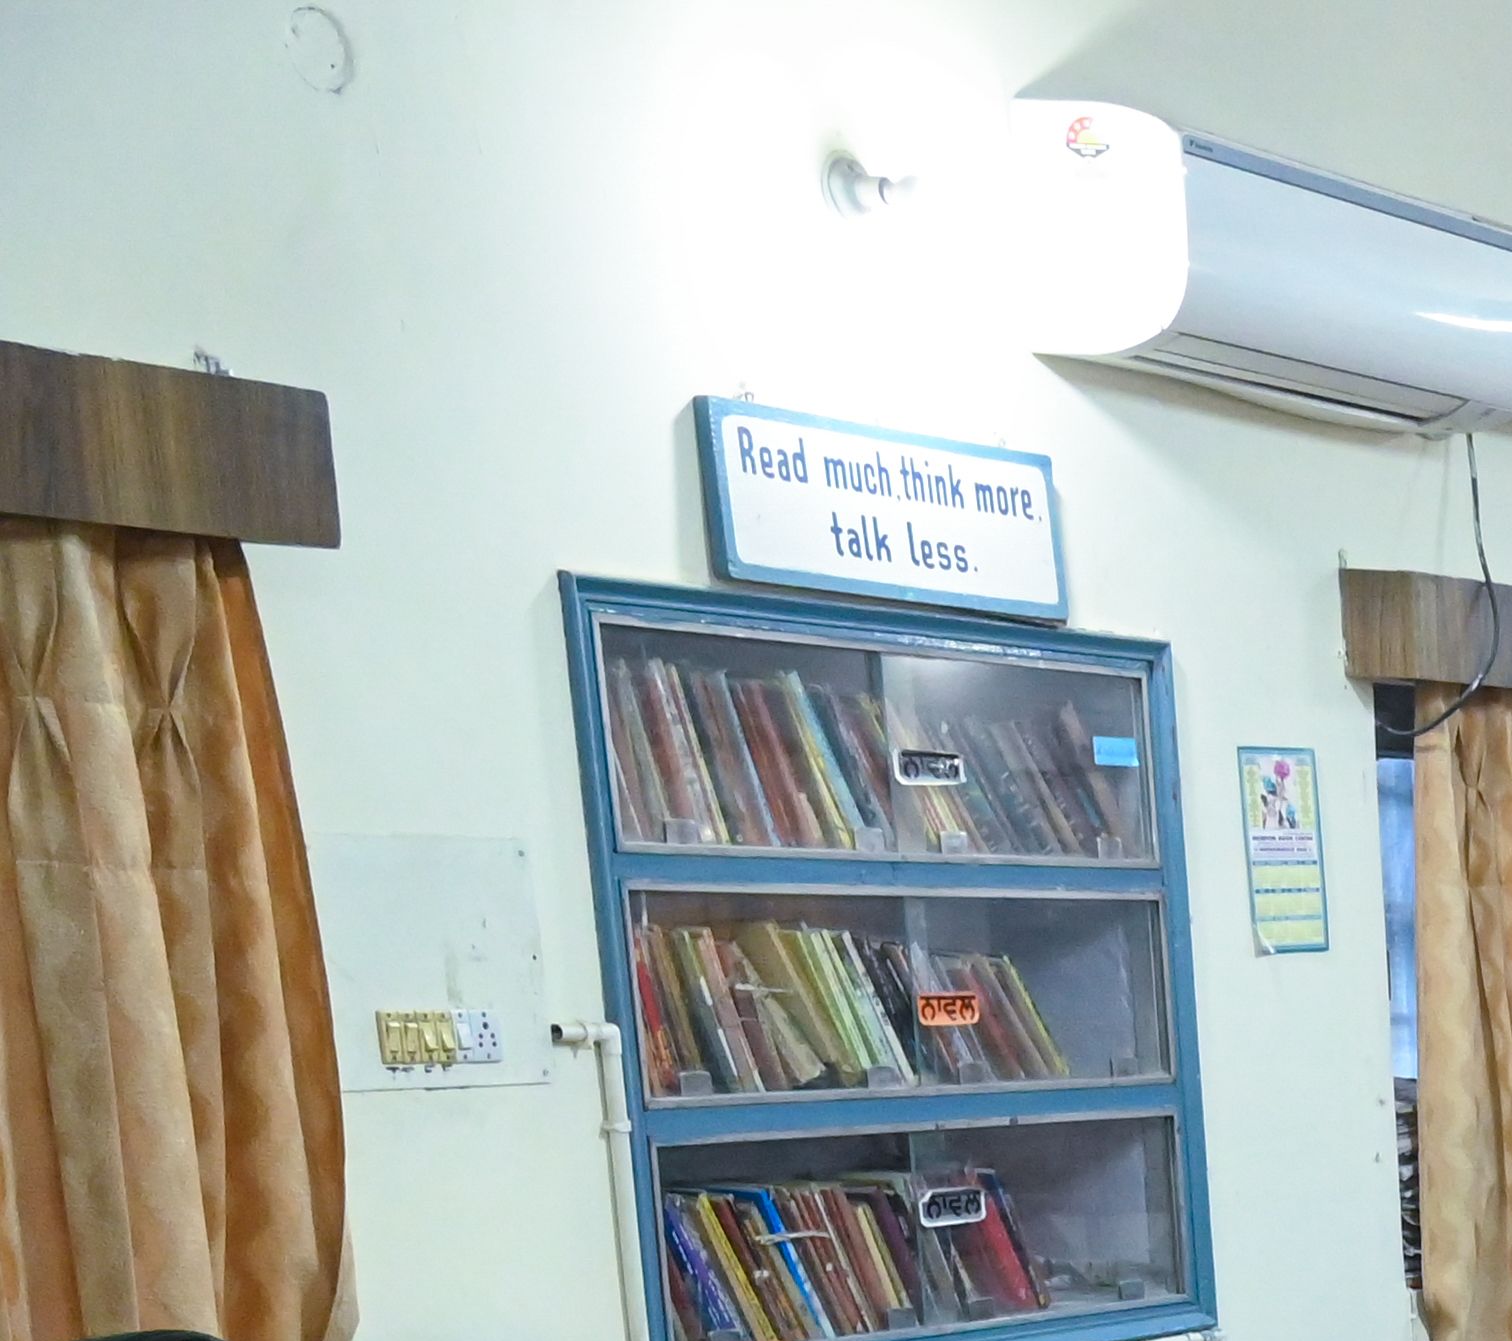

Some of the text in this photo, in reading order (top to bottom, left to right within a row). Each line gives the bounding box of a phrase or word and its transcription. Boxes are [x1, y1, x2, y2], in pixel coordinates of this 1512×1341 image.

[737, 425, 808, 484] Read
[900, 455, 965, 510] think
[830, 511, 979, 573] talk less.
[920, 994, 977, 1020] ਨਾਵਲ
